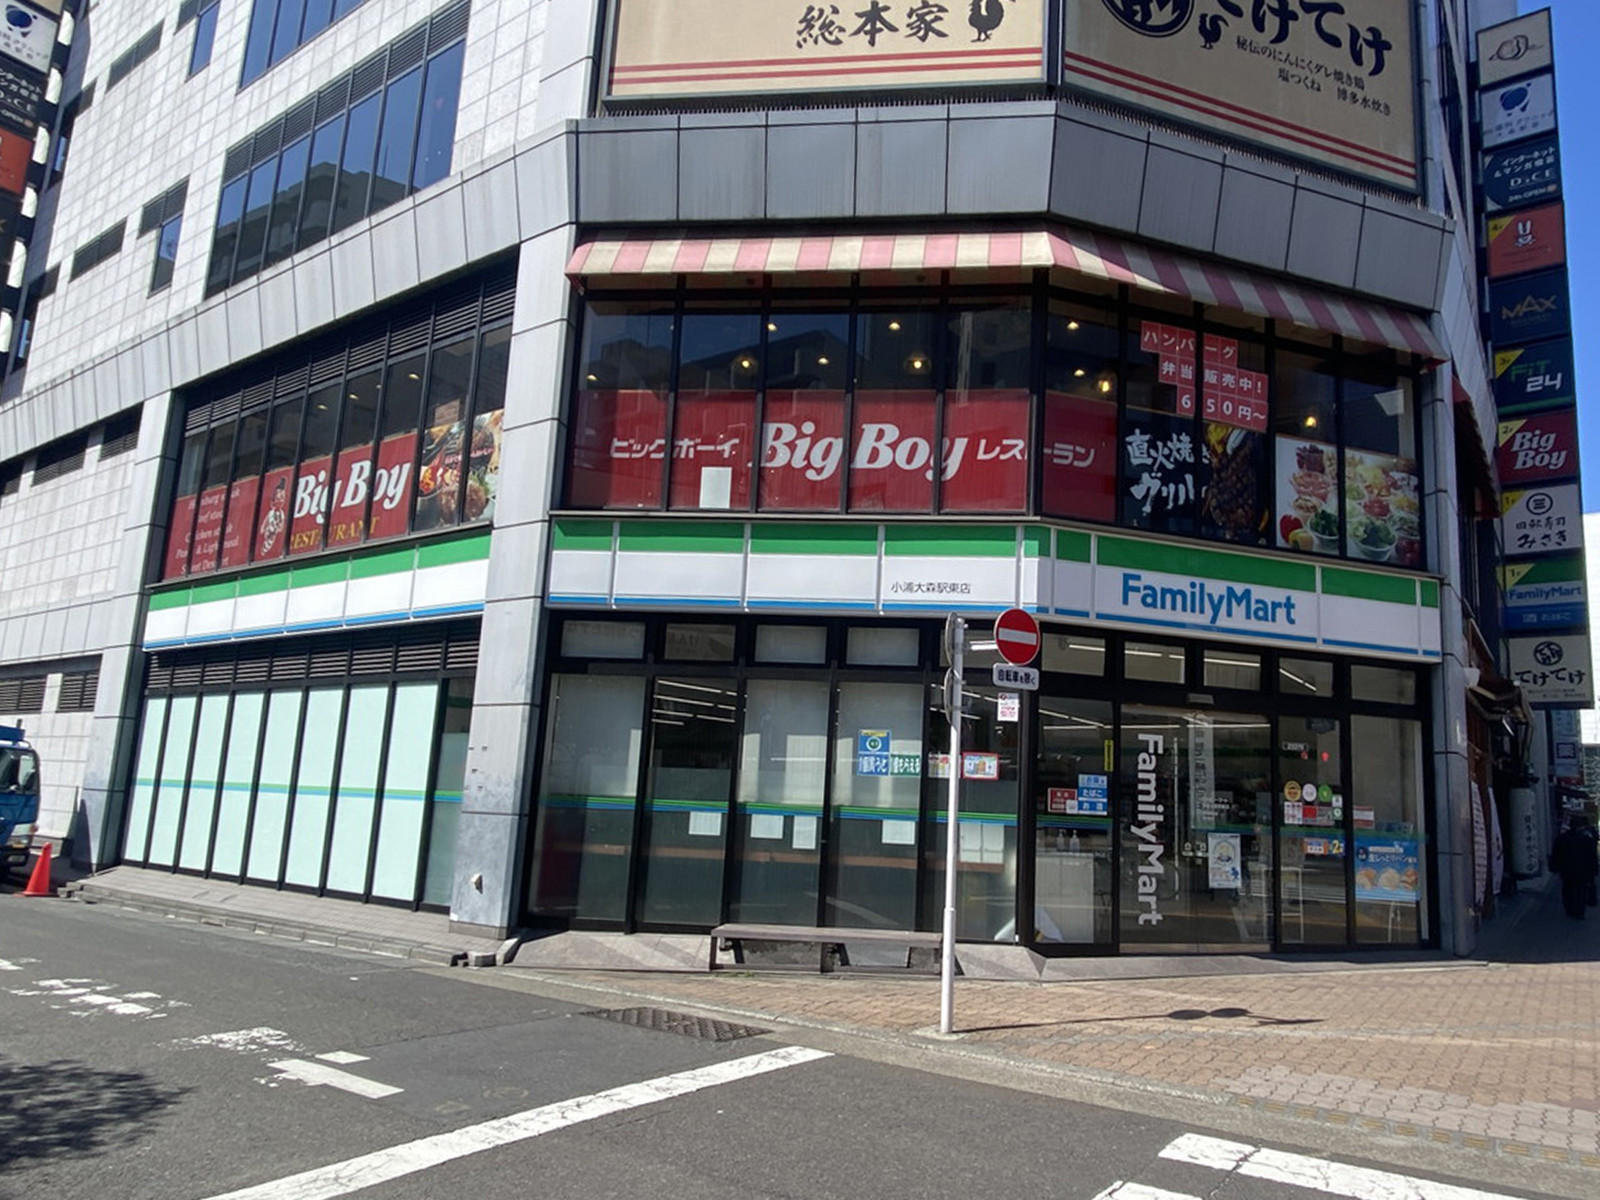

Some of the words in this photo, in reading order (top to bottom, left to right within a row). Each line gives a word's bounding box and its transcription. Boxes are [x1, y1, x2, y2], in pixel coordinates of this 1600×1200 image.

[796, 0, 950, 49] 総本家
[1277, 67, 1322, 93] 塩つくね
[1336, 86, 1392, 117] 博多水炊き
[1502, 294, 1559, 320] MAX
[1144, 331, 1237, 359] ハンバーグ
[1162, 360, 1262, 393] 弁当販売中!
[1525, 371, 1563, 393] 24
[748, 421, 845, 481] Big
[850, 423, 968, 482] Boy
[1511, 430, 1557, 452] Big
[1514, 450, 1568, 470] Boy
[1122, 572, 1296, 625] FamilyMart
[1508, 585, 1582, 601] FamilyMart
[1515, 667, 1586, 687] てけてけ
[1130, 733, 1165, 926] FamilyMart
